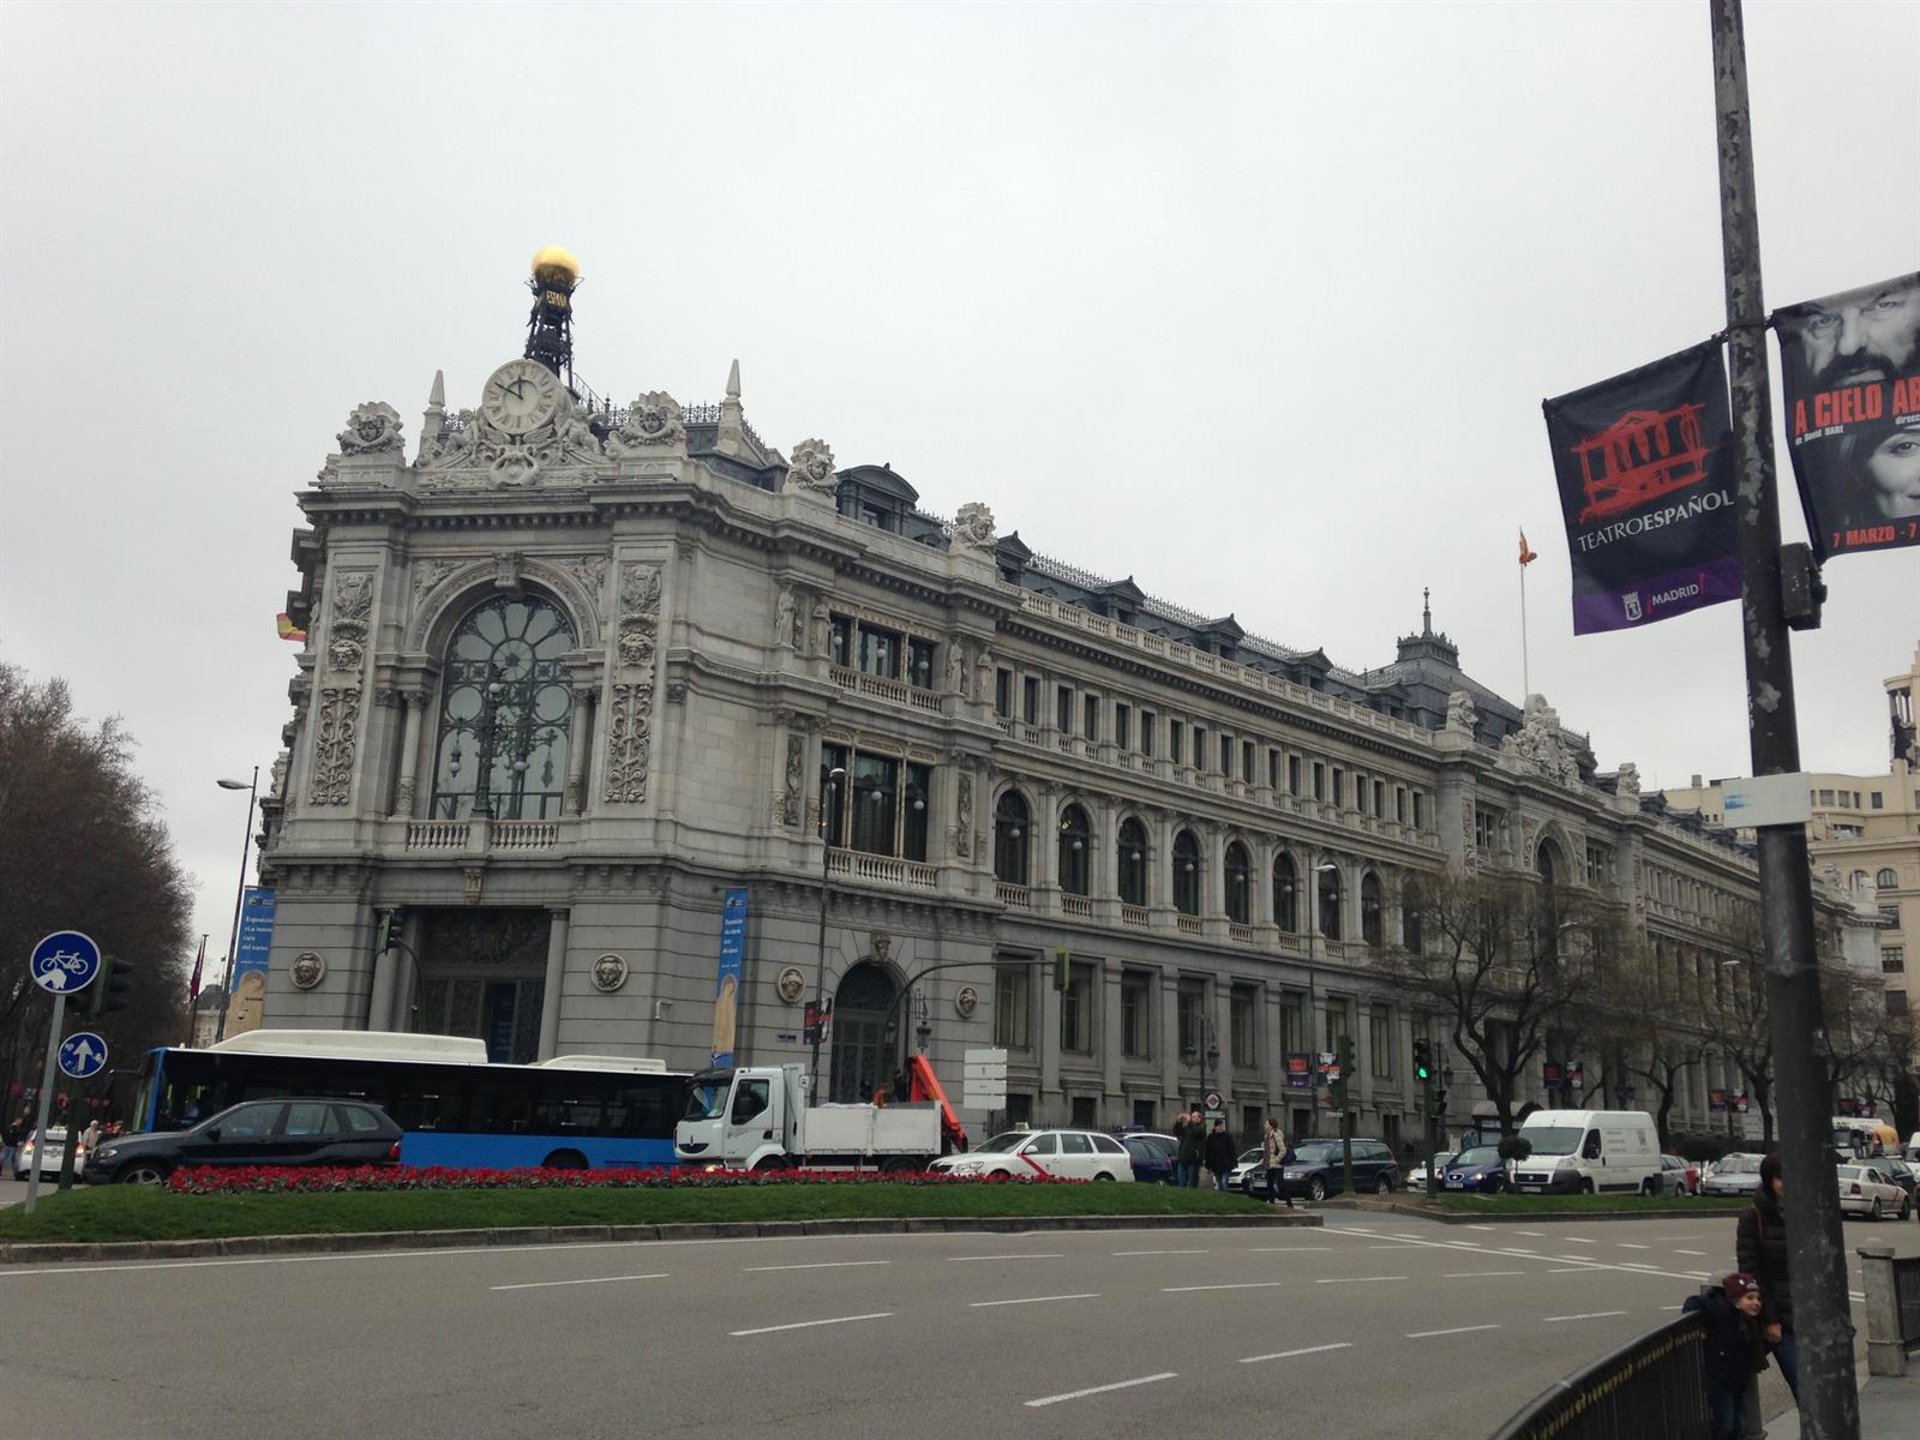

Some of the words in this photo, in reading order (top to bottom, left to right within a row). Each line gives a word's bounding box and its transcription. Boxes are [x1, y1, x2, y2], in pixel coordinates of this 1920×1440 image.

[1795, 399, 1808, 437] A
[1815, 383, 1883, 428] CIELO
[1577, 489, 1735, 551] TEATROESPAÑOL
[1832, 532, 1840, 548] 7
[1845, 525, 1895, 546] MARZO
[1908, 522, 1917, 539] 7
[1651, 583, 1700, 606] MADRID
